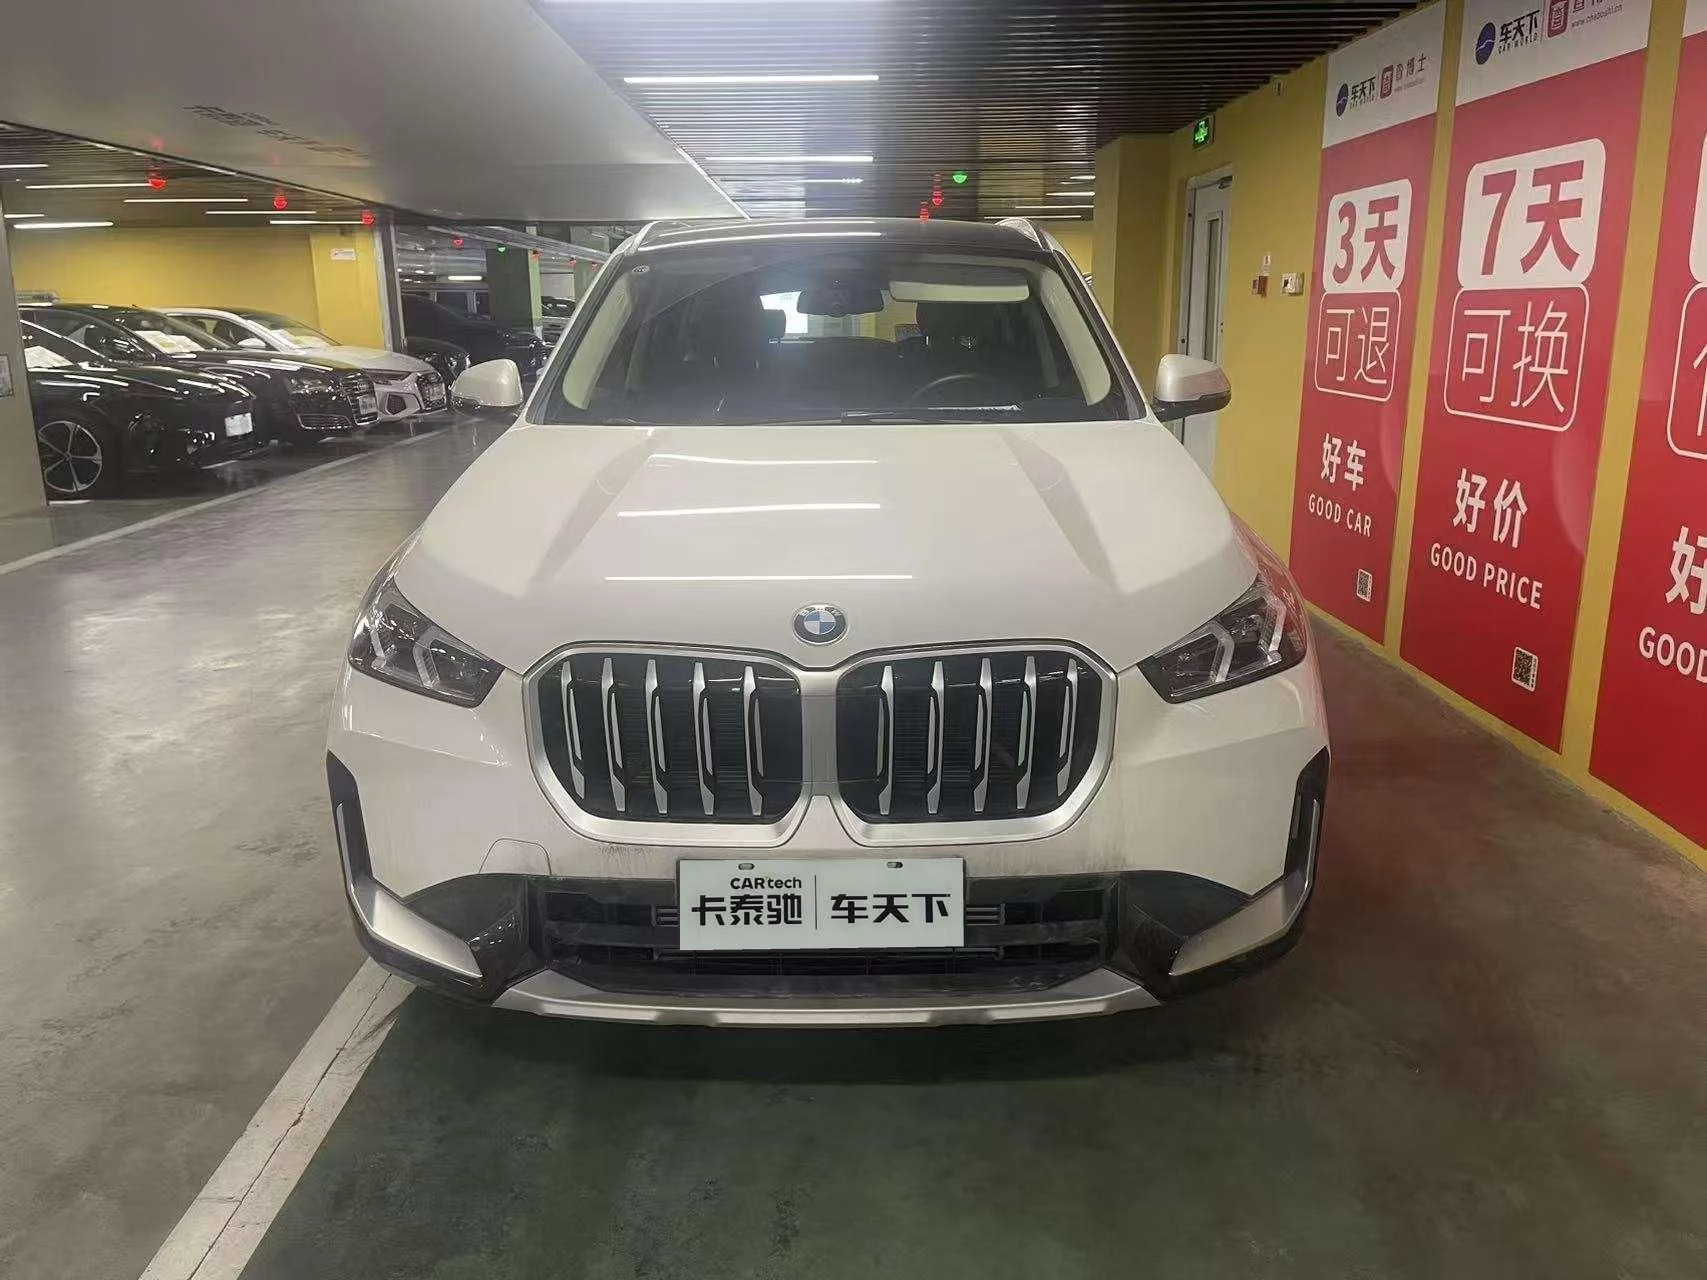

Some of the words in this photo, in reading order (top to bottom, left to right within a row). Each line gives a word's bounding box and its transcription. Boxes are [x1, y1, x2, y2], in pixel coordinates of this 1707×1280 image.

[1499, 9, 1541, 43] 车天下
[1332, 195, 1399, 284] 3天
[1481, 160, 1584, 276] 7天
[1325, 306, 1391, 384] 可退
[1461, 300, 1569, 413] 可换
[1320, 432, 1367, 491] 好车
[1308, 493, 1341, 524] GOOD
[1346, 507, 1372, 538] CAR
[1451, 467, 1528, 549] 好价
[1430, 542, 1477, 582] GOOD
[1483, 562, 1543, 610] PRICE
[691, 894, 802, 926] 卡泰驰
[830, 893, 951, 924] 车天下
